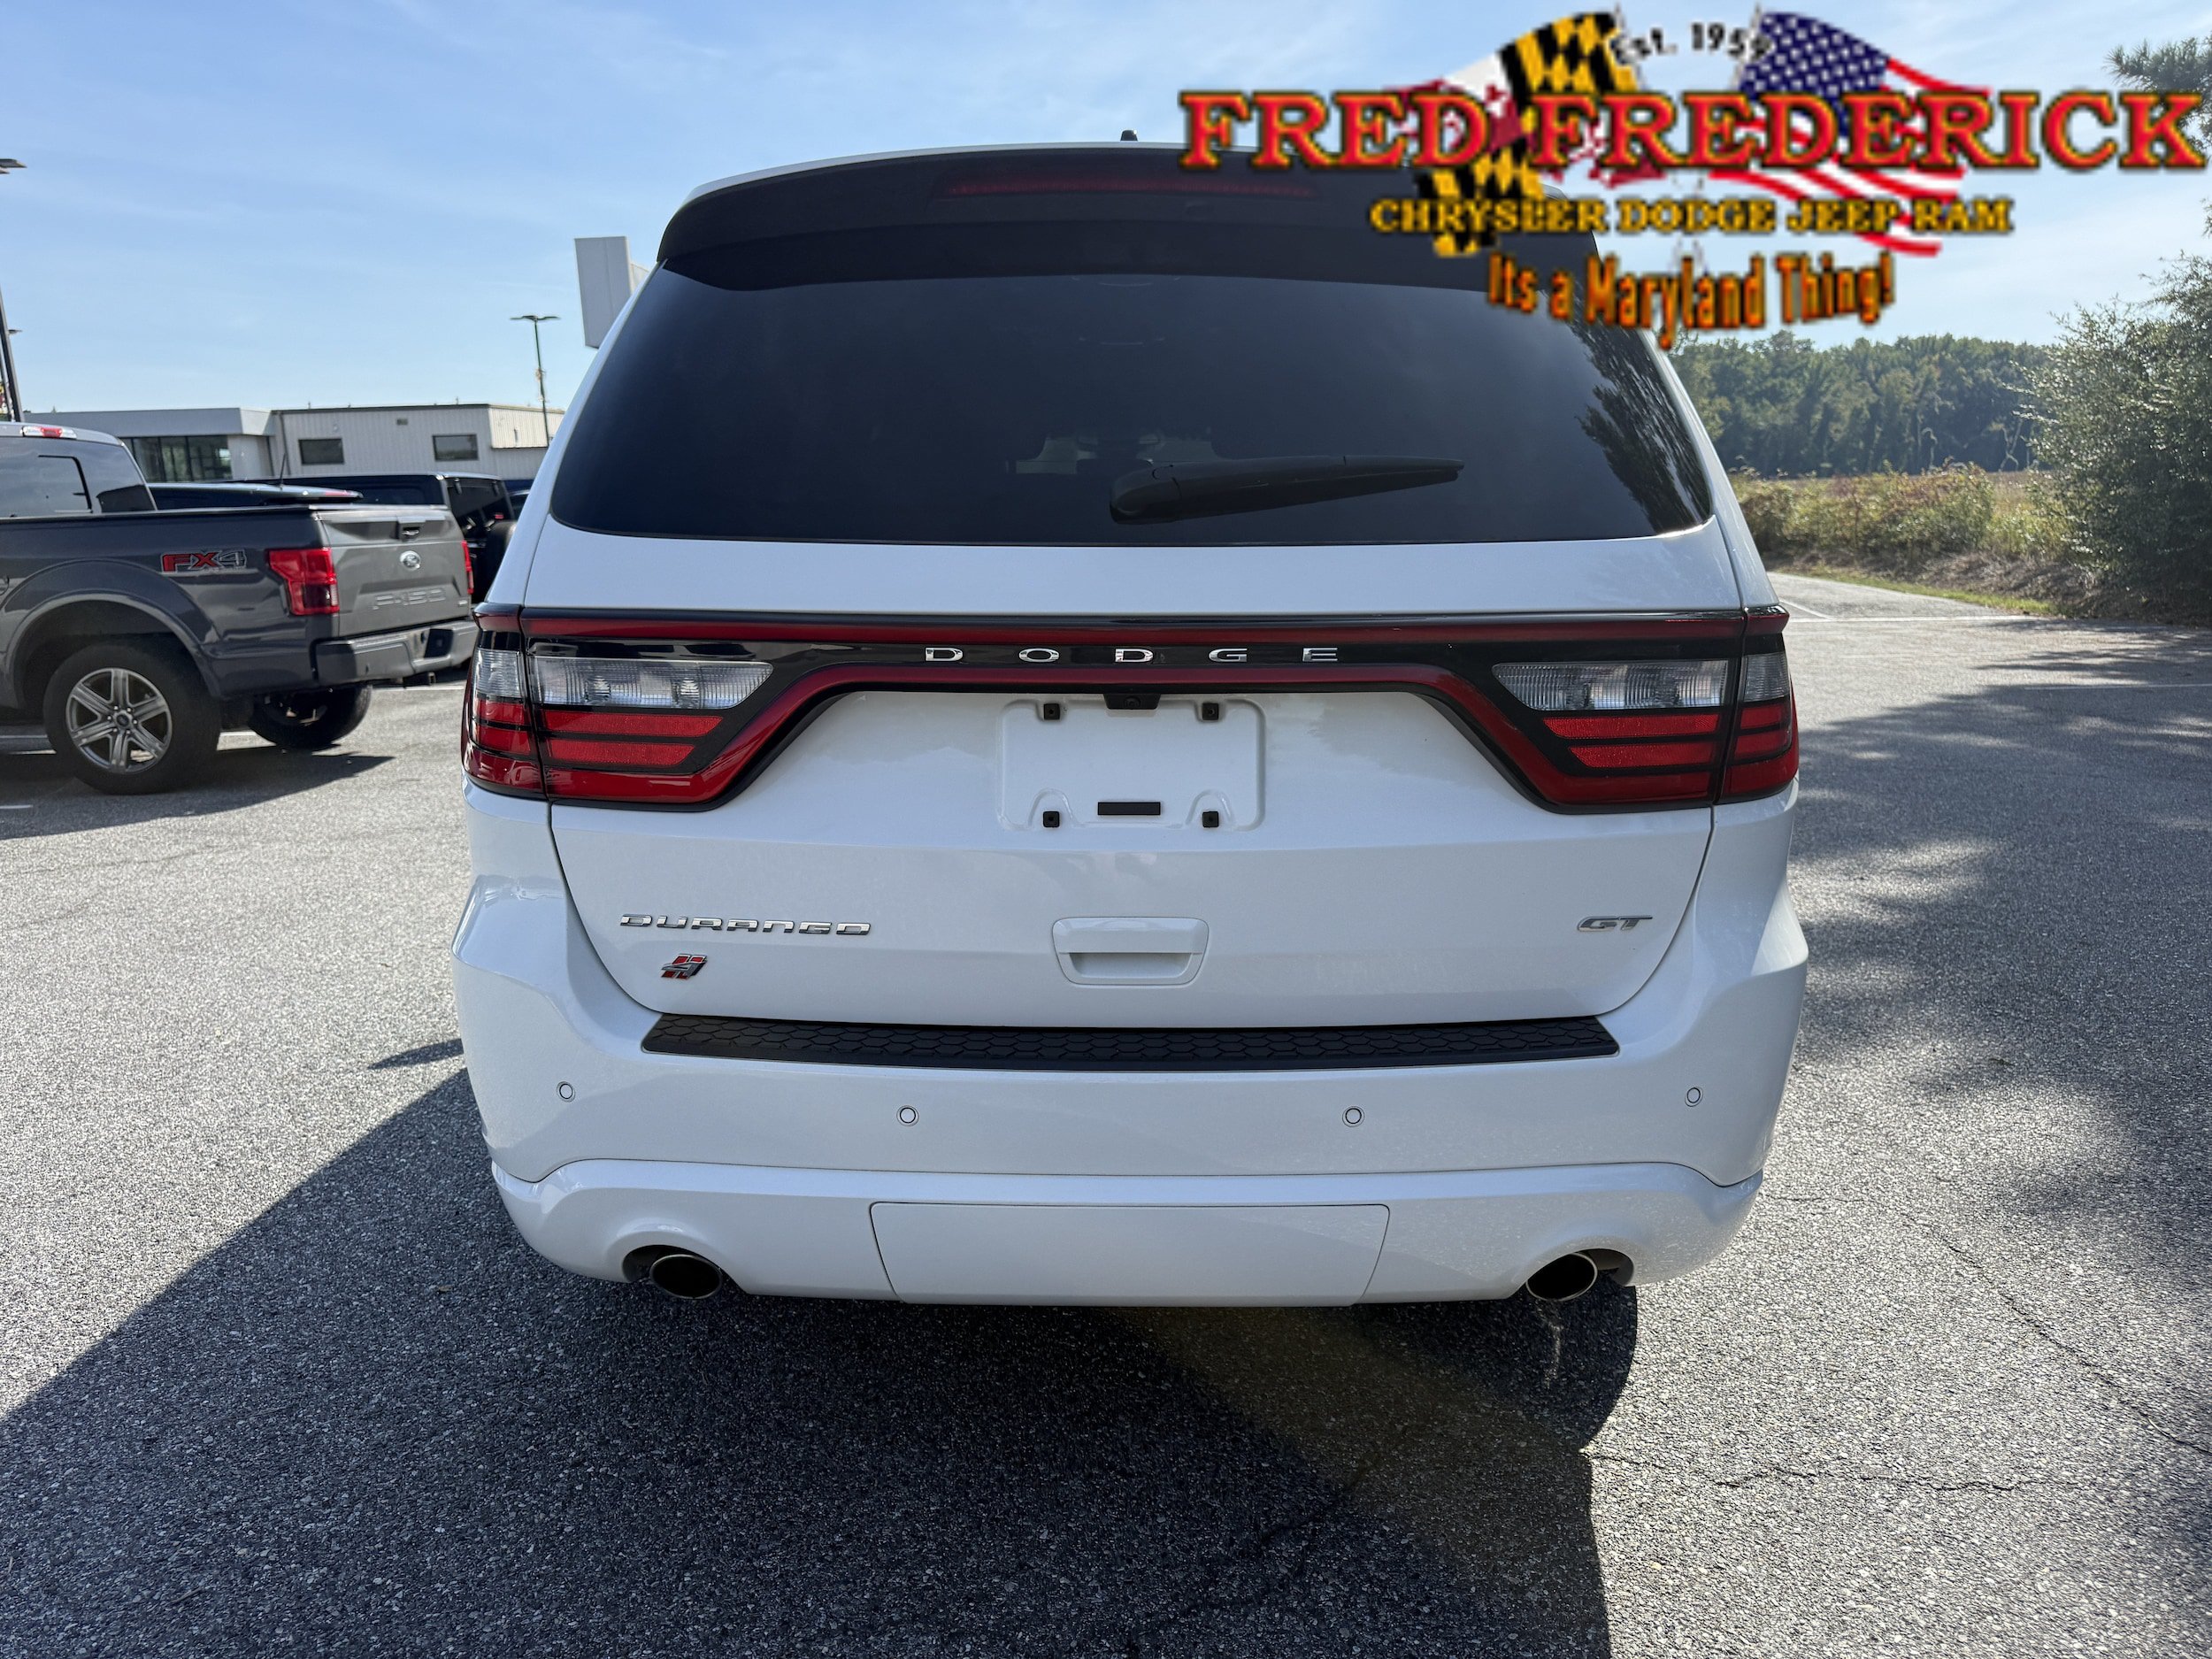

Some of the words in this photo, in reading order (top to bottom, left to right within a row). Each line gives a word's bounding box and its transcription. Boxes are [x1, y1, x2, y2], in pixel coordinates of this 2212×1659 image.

[160, 549, 247, 573] FX4
[925, 647, 1338, 663] DODGE
[620, 913, 872, 936] DURANGO
[1577, 916, 1653, 932] GT
